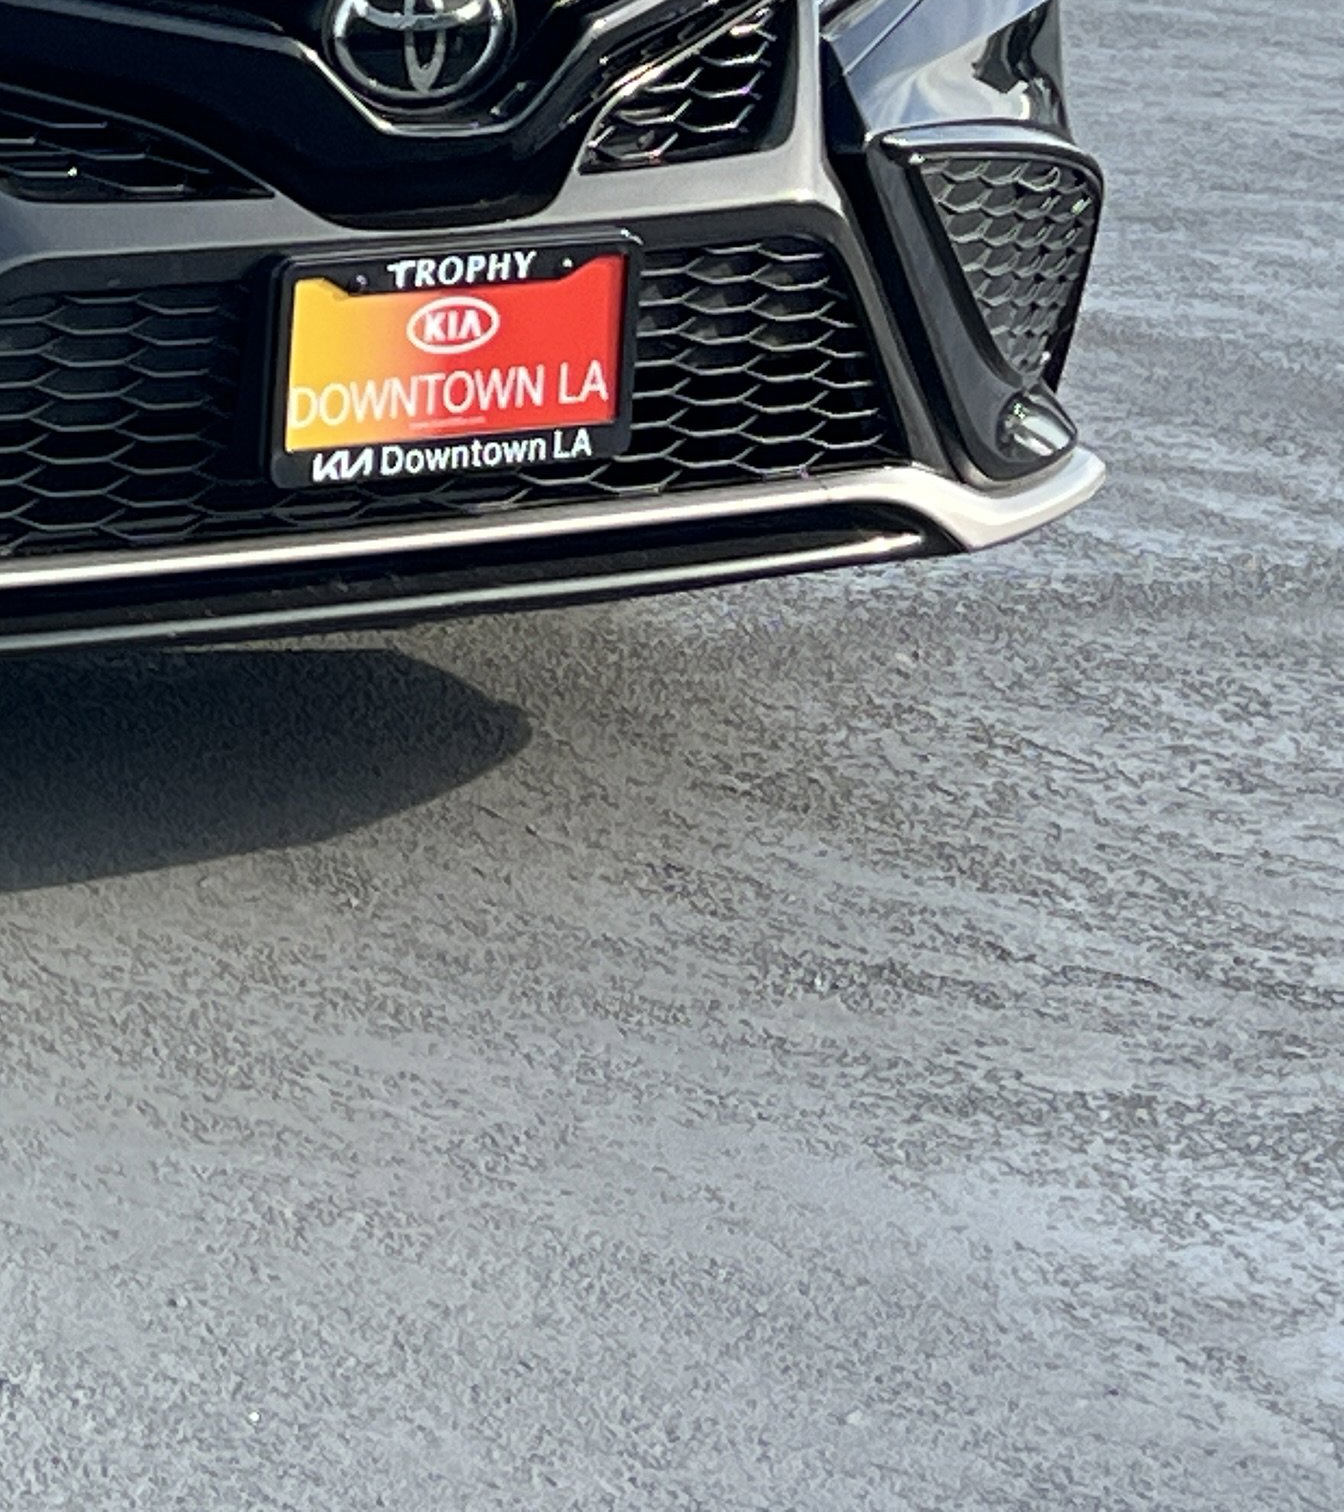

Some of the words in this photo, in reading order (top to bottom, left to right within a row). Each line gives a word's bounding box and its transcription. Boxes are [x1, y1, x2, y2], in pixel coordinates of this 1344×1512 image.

[387, 250, 537, 289] TROPHY
[424, 310, 483, 343] KIA
[289, 364, 545, 430] DOWNTOWN
[559, 359, 610, 406] LA
[380, 436, 547, 476] Downtown
[553, 428, 593, 459] LA
